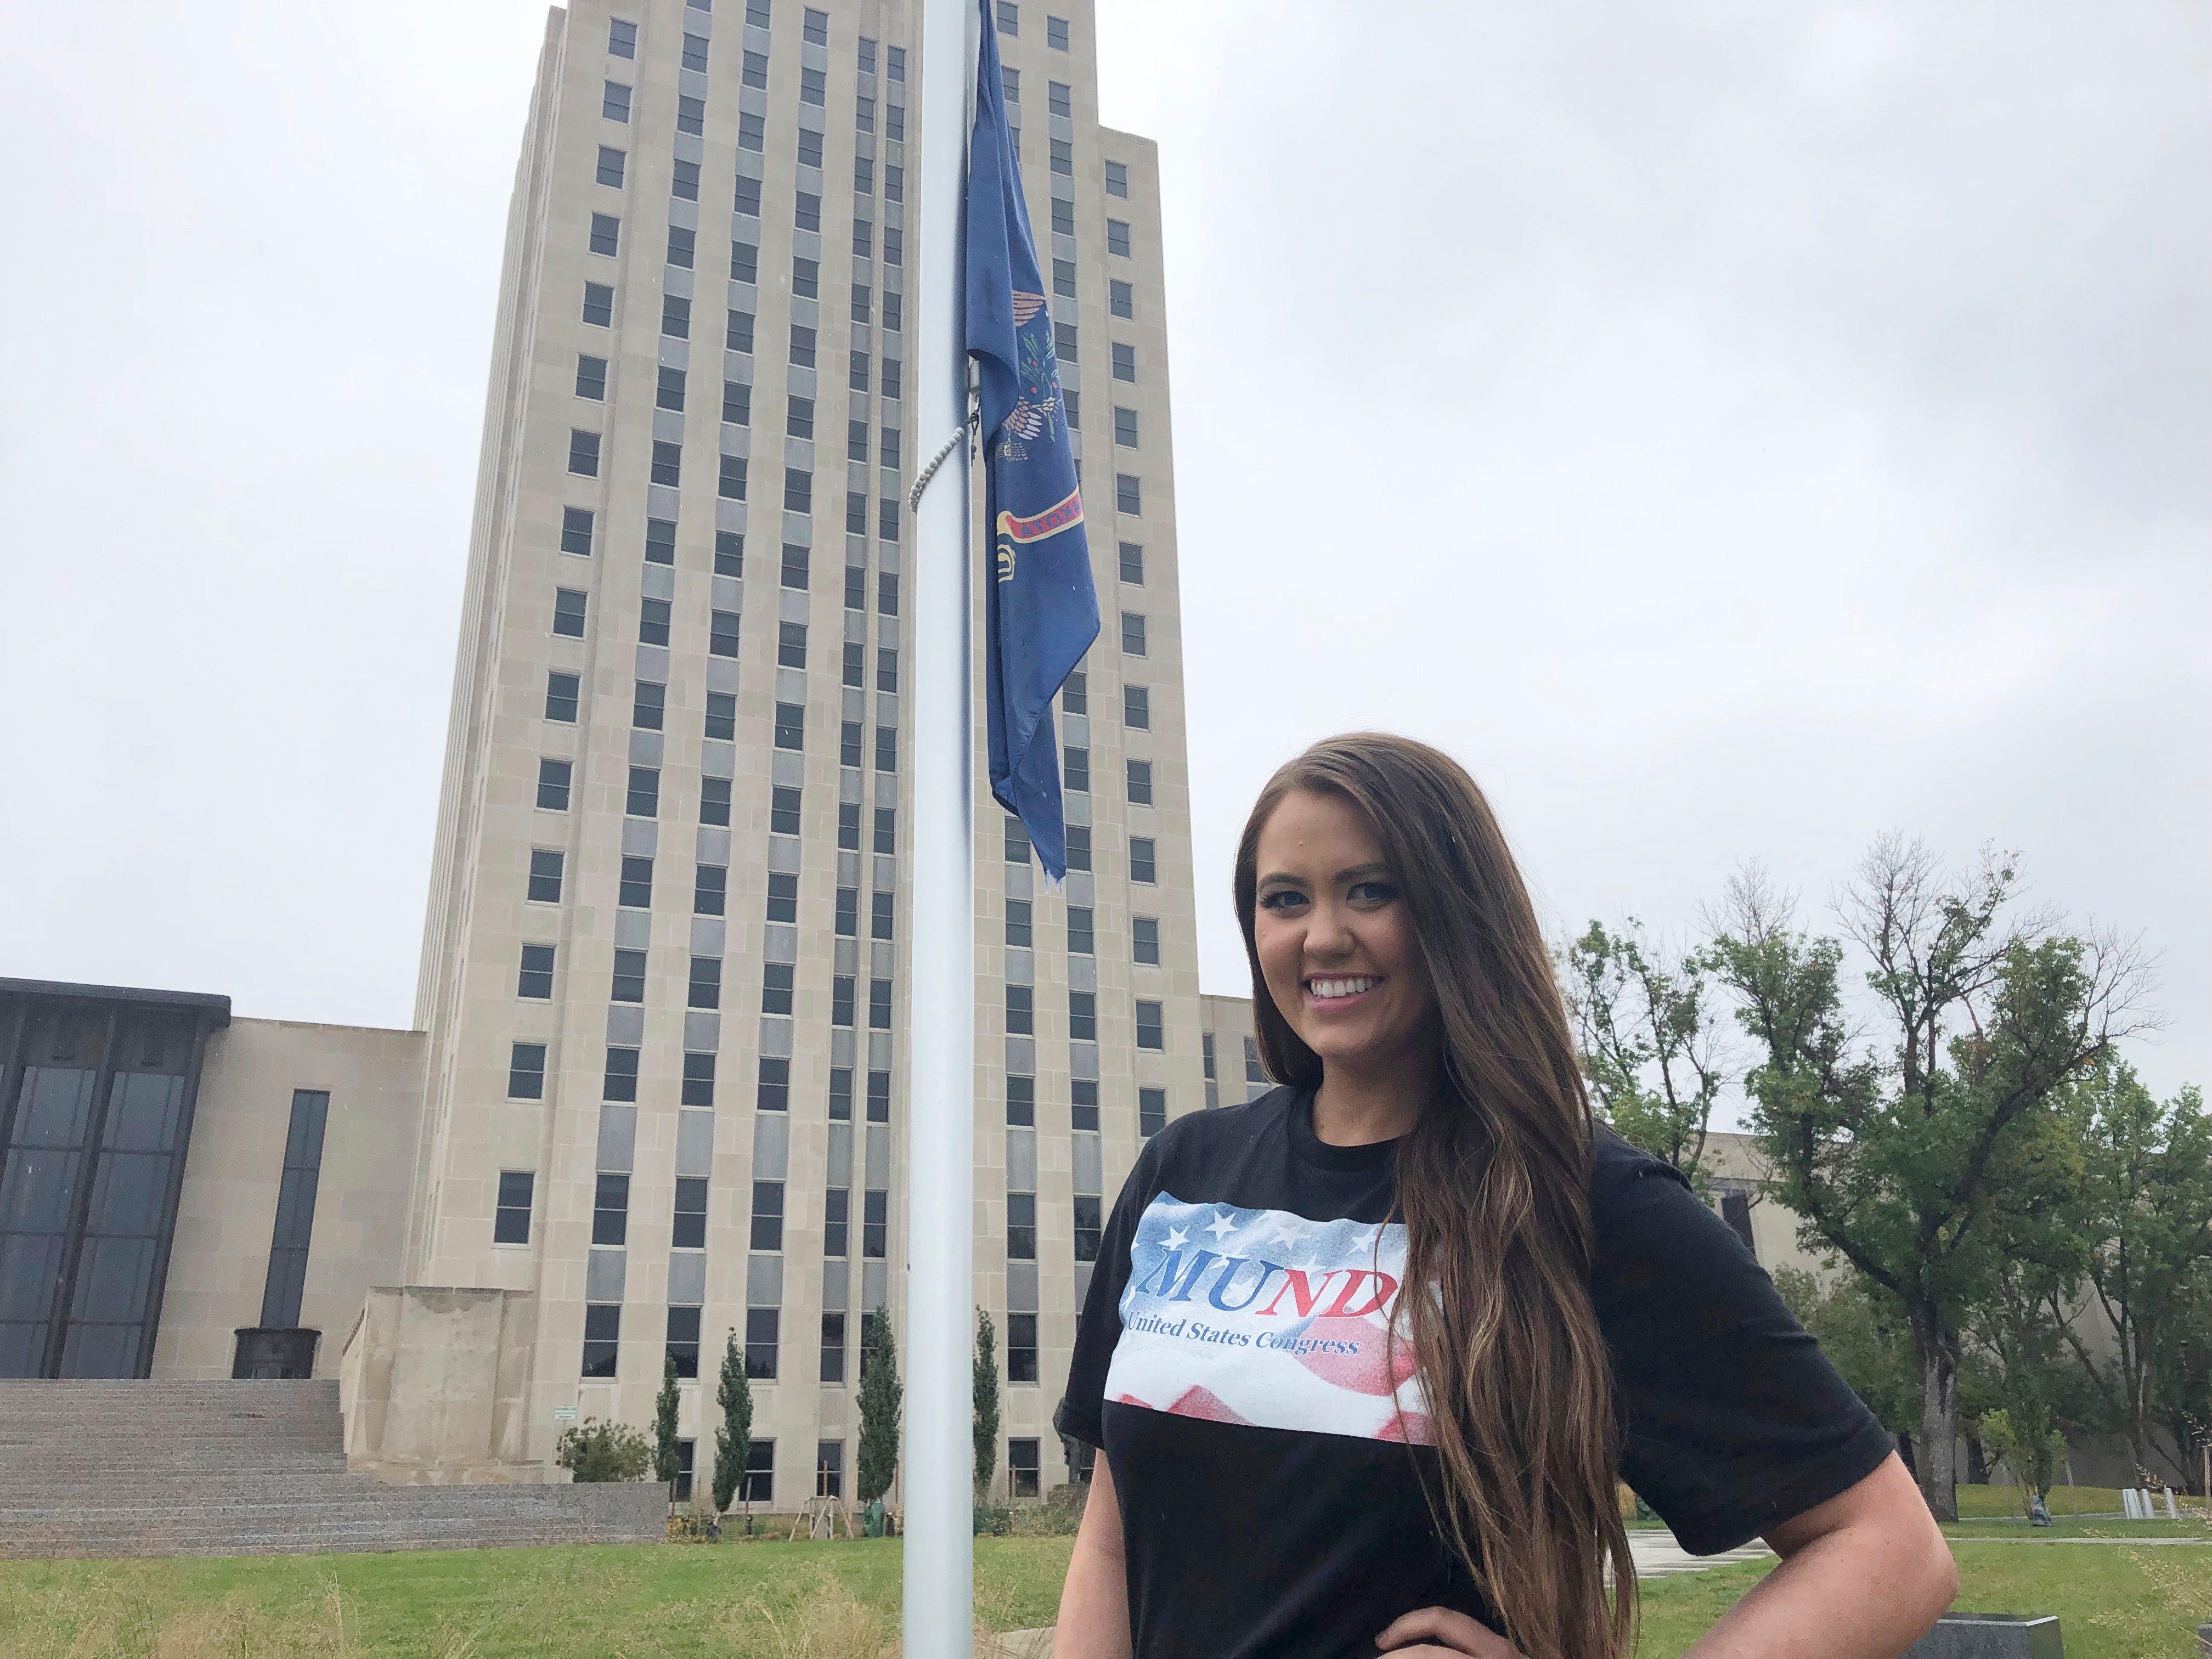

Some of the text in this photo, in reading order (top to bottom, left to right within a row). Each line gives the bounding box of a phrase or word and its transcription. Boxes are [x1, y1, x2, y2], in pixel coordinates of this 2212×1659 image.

[1135, 1248, 1398, 1318] MUND
[1128, 1312, 1359, 1356] United States Congress
